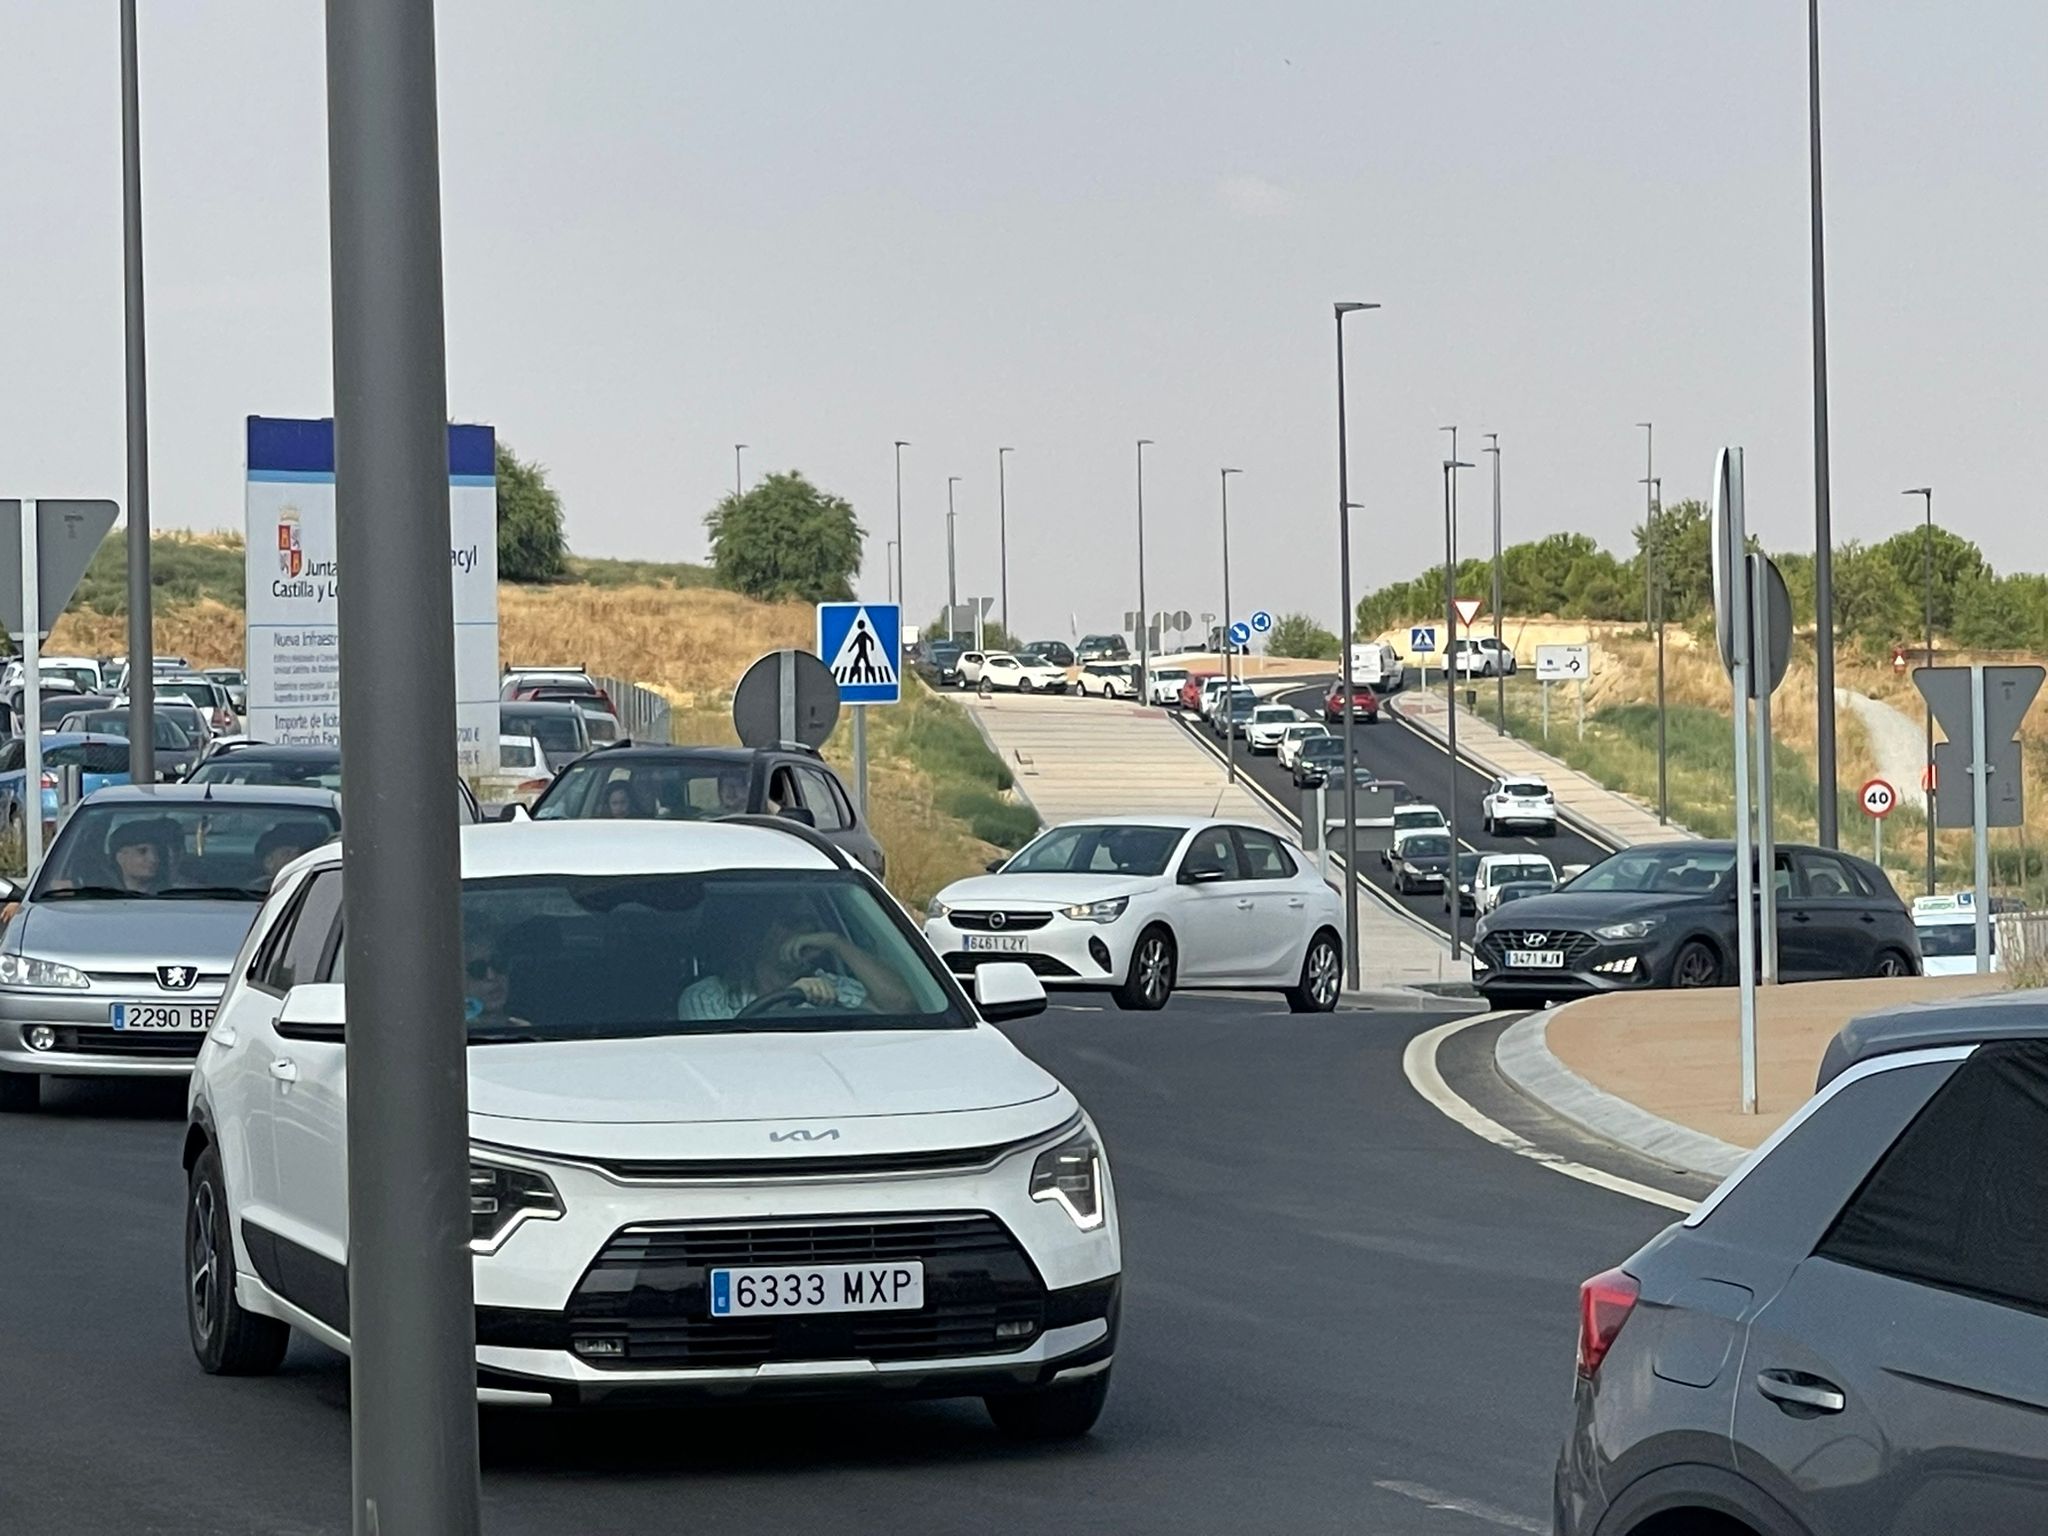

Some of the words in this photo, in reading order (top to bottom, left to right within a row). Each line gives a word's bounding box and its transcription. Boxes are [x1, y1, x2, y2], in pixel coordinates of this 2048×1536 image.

[272, 580, 314, 598] Castilla
[317, 584, 325, 603] y
[1867, 791, 1889, 805] 40
[970, 937, 999, 950] 6461
[1002, 937, 1025, 951] LZY
[129, 1008, 181, 1028] 2290
[737, 1273, 826, 1308] 6333
[843, 1269, 912, 1304] MXP
